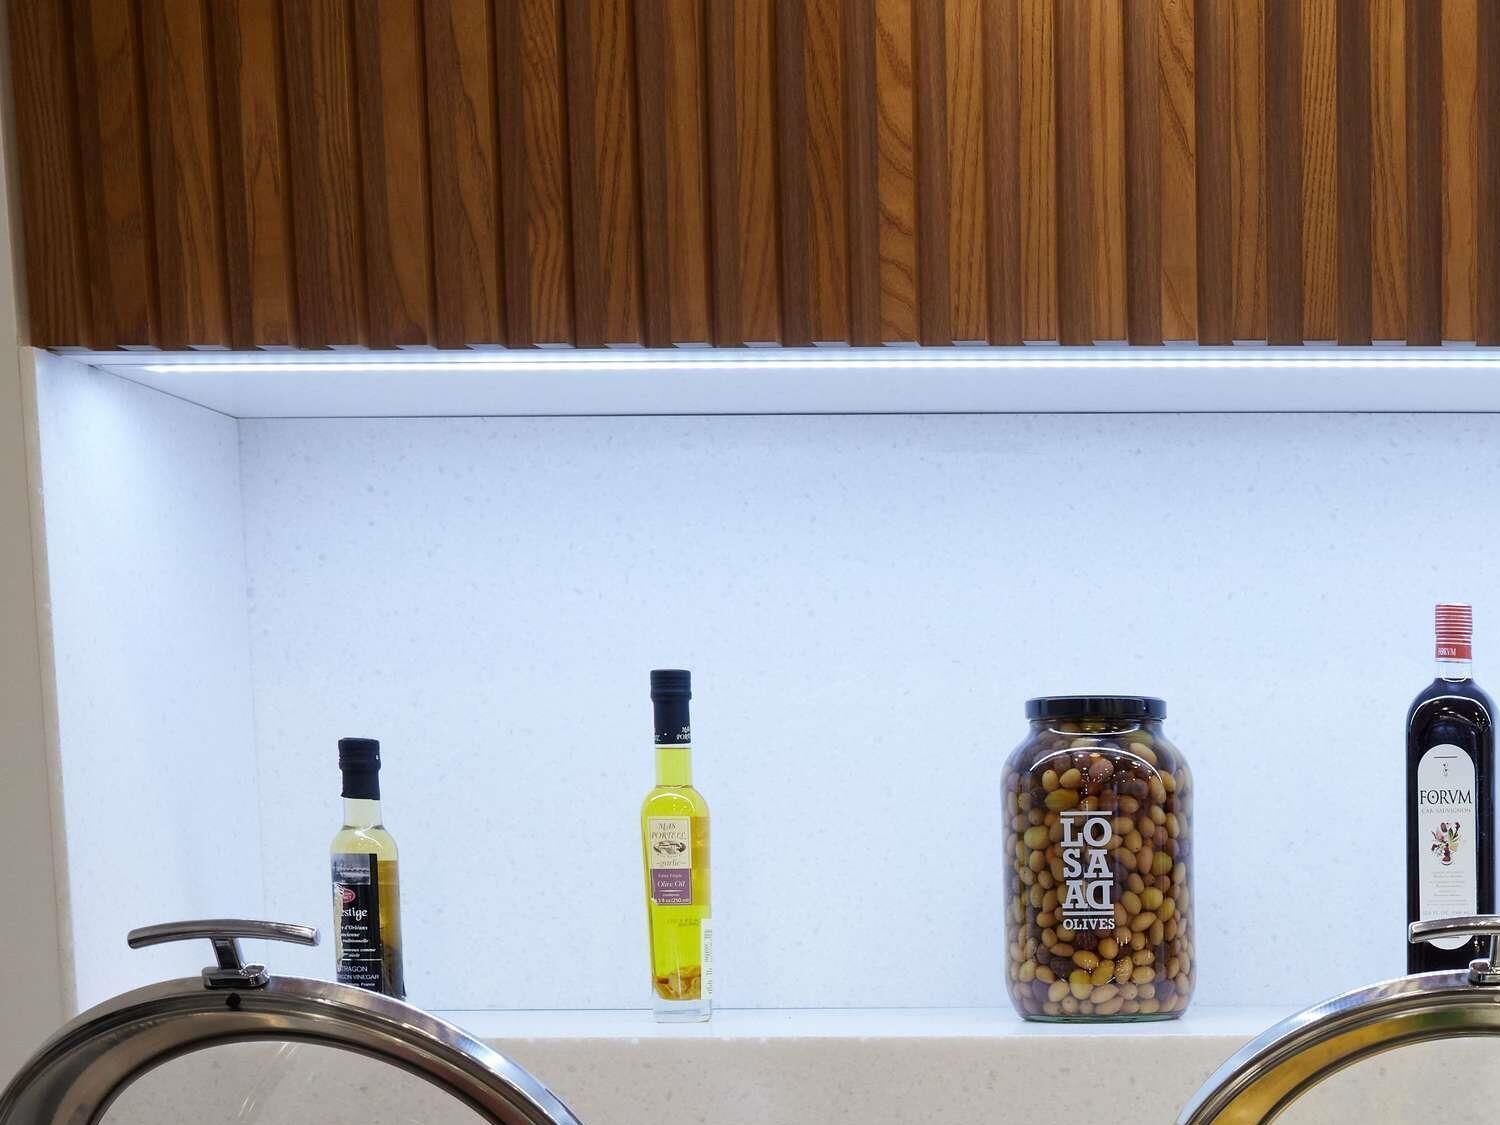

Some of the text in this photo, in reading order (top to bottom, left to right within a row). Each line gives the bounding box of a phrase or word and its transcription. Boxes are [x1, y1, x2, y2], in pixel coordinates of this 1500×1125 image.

[1419, 789, 1473, 805] FORVM
[340, 907, 368, 921] estige
[1062, 918, 1115, 930] OLIVES
